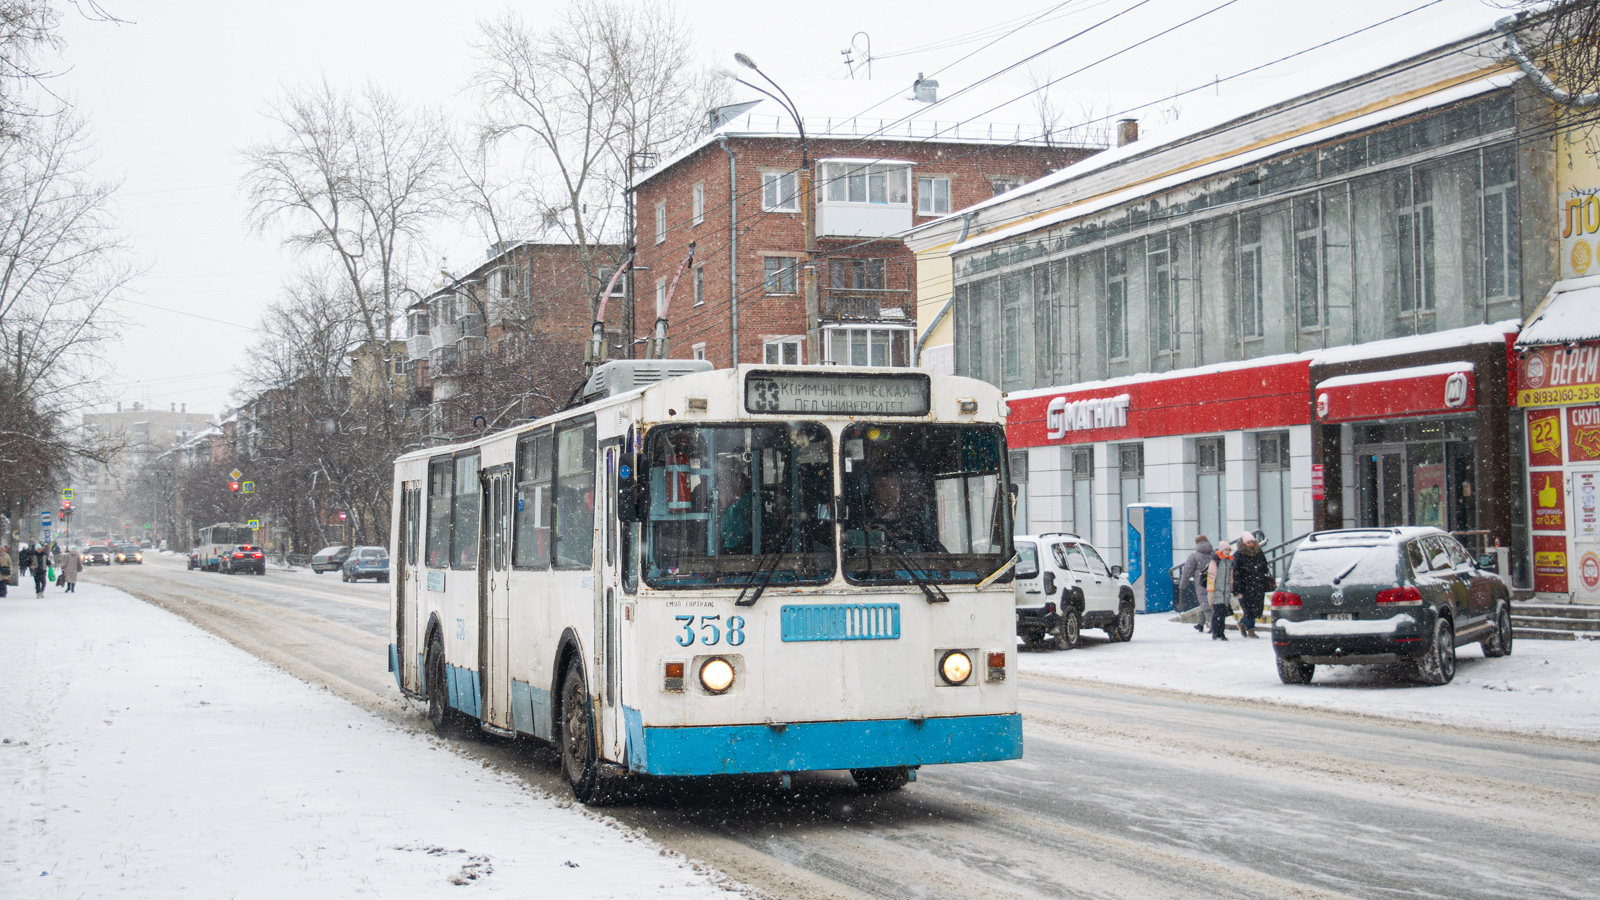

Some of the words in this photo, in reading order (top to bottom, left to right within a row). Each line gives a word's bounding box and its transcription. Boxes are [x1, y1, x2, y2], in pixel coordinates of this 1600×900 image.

[1550, 346, 1600, 386] БЕРЕМ
[754, 381, 780, 411] 33
[1064, 397, 1130, 431] МАГНИТ
[1534, 420, 1553, 444] 22
[674, 614, 745, 647] 358
